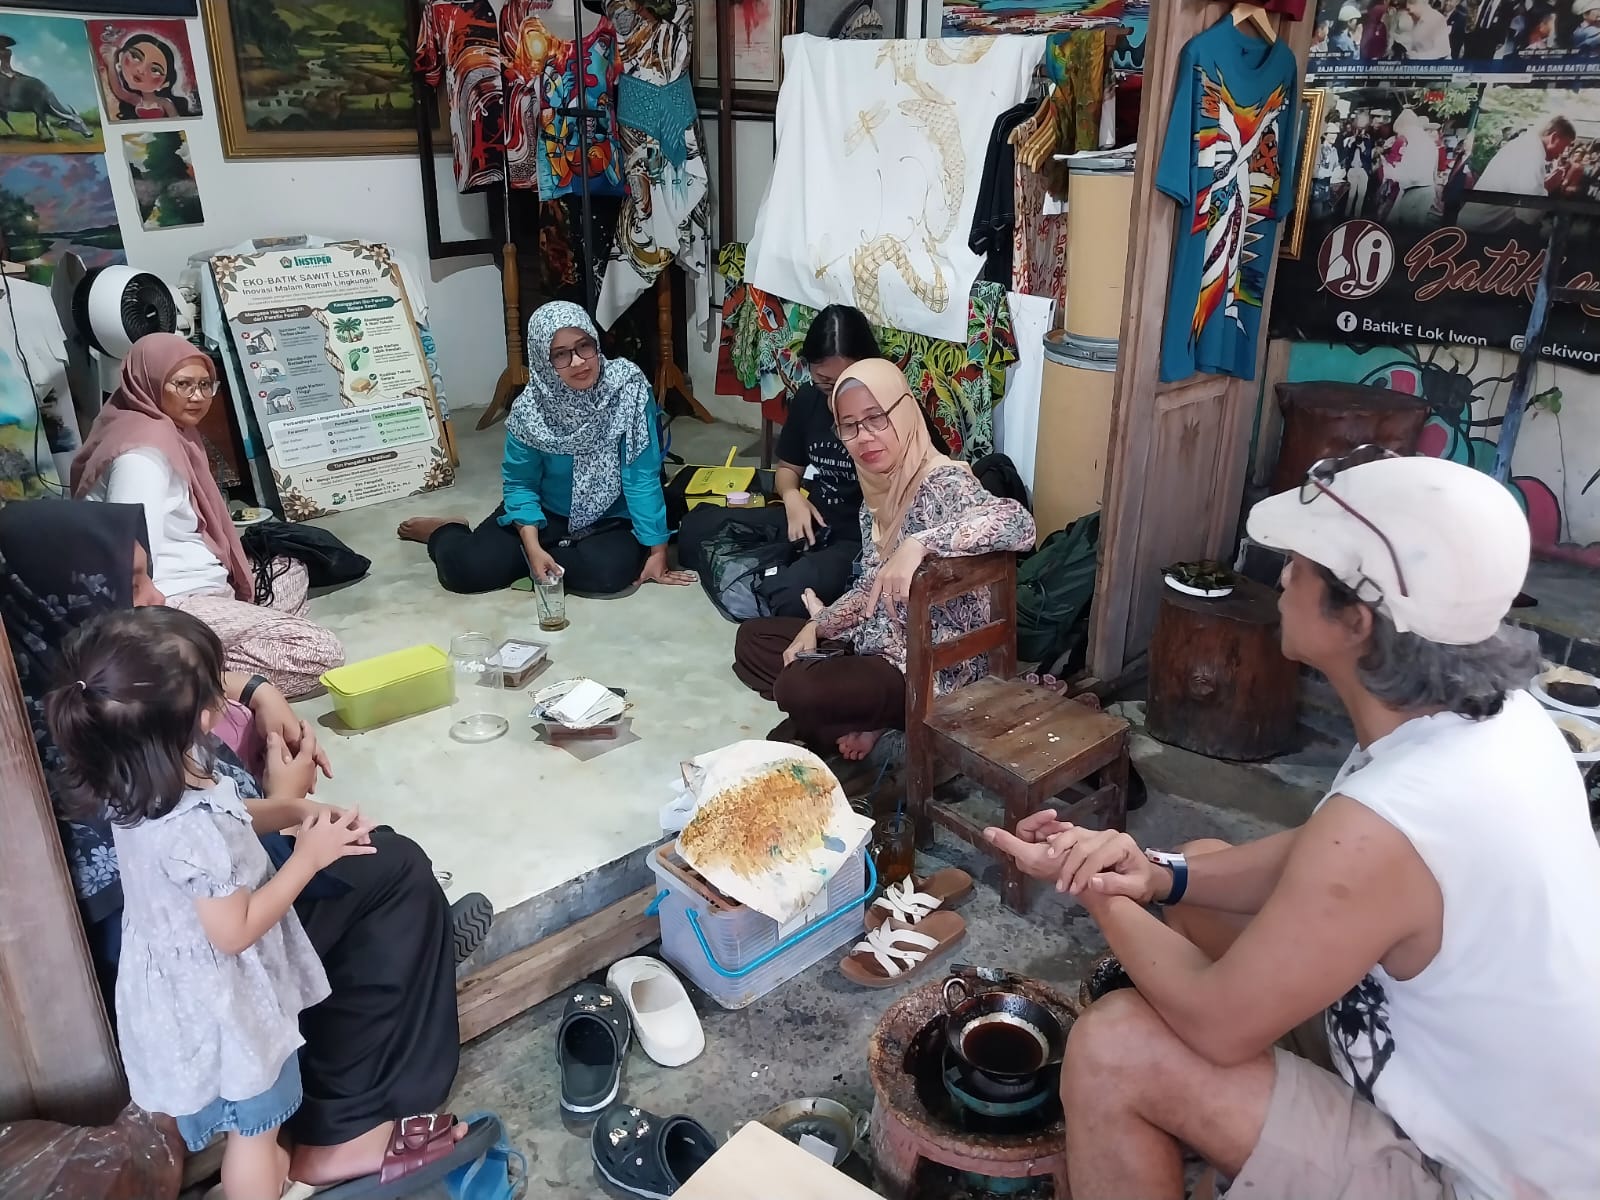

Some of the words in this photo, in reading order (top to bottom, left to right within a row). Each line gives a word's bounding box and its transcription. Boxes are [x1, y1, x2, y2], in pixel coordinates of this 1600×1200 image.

[293, 253, 332, 266] INSTIPER
[242, 275, 297, 286] EKO-BATIK
[299, 272, 330, 281] SAWIT
[332, 268, 370, 277] LESTARI
[242, 287, 272, 295] Inovasi
[333, 276, 378, 287] Lingkungan
[1418, 325, 1444, 341] Lok
[1449, 329, 1488, 346] Iwon
[1541, 343, 1600, 362] ekiwo
